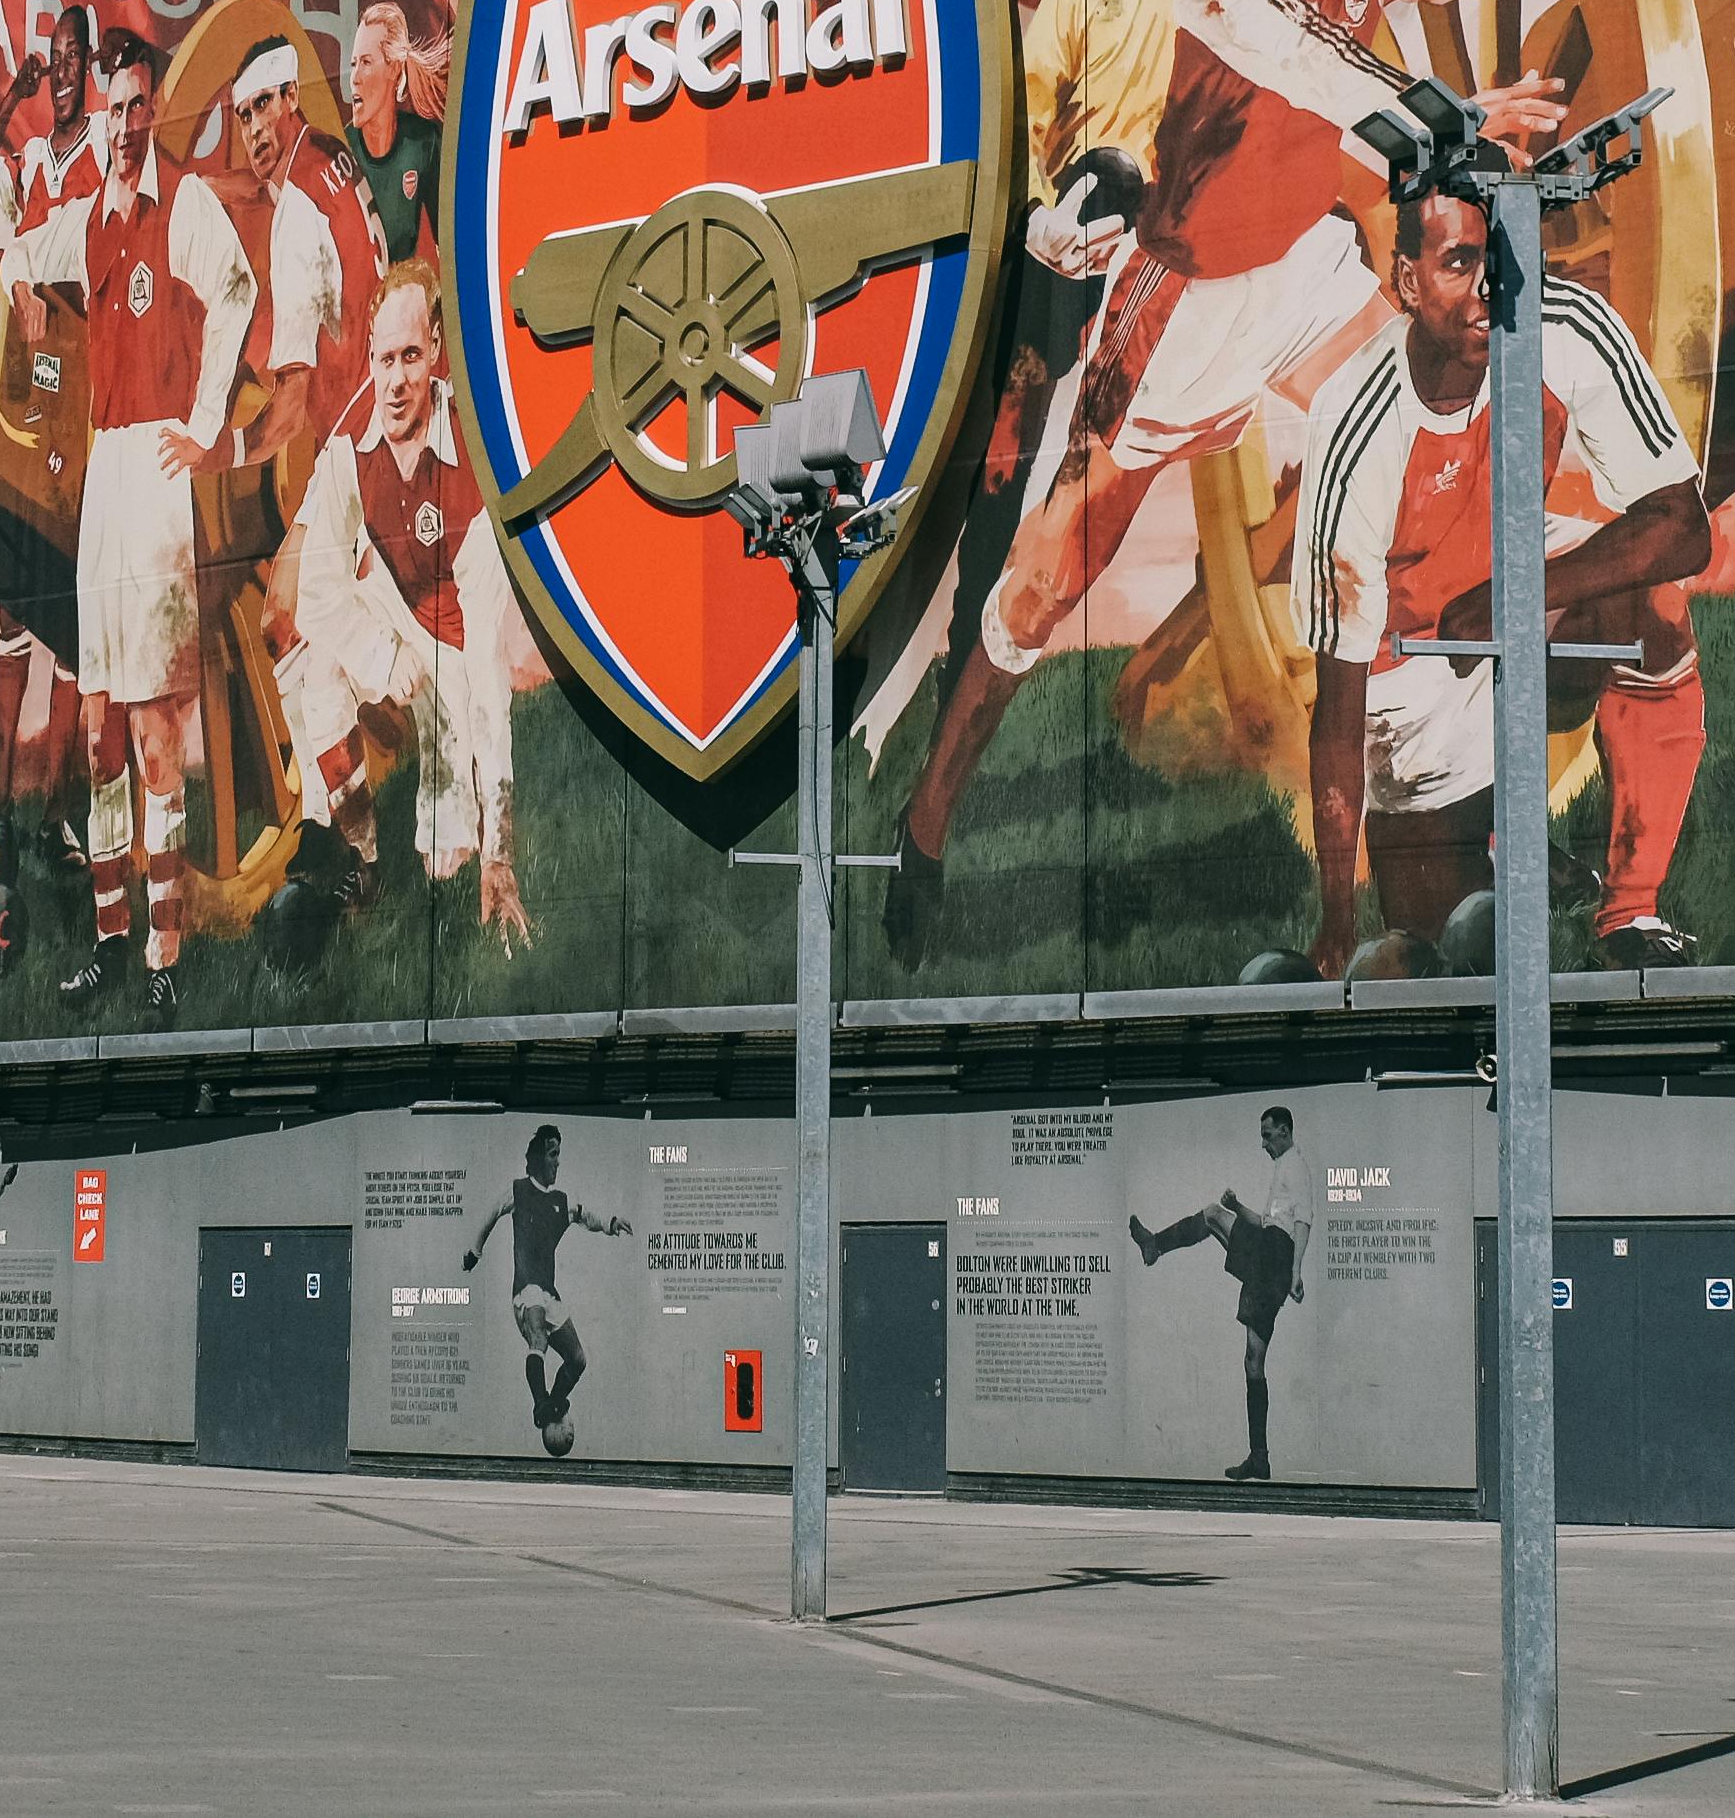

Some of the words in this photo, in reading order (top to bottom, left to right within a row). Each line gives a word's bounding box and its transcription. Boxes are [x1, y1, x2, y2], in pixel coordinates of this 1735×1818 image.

[33, 370, 58, 390] MAGIC
[48, 451, 63, 475] 49
[649, 1146, 664, 1163] THE
[666, 1146, 688, 1163] FANS
[1327, 1168, 1357, 1187] DAVID
[1360, 1167, 1390, 1187] JACK
[957, 1198, 973, 1216] THE
[976, 1198, 1000, 1216] FANS
[648, 1233, 661, 1250] HIS
[663, 1233, 700, 1250] ATTITUDE
[704, 1233, 743, 1249] TOWARDS
[746, 1233, 757, 1249] ME
[648, 1253, 688, 1270] CEMENTED
[690, 1253, 702, 1270] MY
[704, 1253, 724, 1270] LOVE
[726, 1253, 741, 1270] FOR
[744, 1253, 759, 1270] THE
[762, 1253, 787, 1270] CLUB.
[956, 1256, 990, 1273] BOLTON
[993, 1256, 1017, 1273] WERE
[1021, 1256, 1070, 1273] UNWILLING
[1074, 1256, 1085, 1273] TO
[1089, 1256, 1111, 1273] SELL
[957, 1277, 1003, 1294] PROBABLY
[1006, 1277, 1023, 1294] THE
[1025, 1277, 1048, 1294] BEST
[1051, 1277, 1092, 1294] STRIKER
[392, 1288, 420, 1304] GEORGE
[421, 1287, 470, 1304] ARMSTRONG
[957, 1299, 965, 1316] IN
[968, 1299, 984, 1316] THE
[987, 1299, 1018, 1316] WORLD
[1021, 1299, 1032, 1316] AT
[1036, 1299, 1052, 1316] THE
[1055, 1299, 1080, 1316] TIME.
